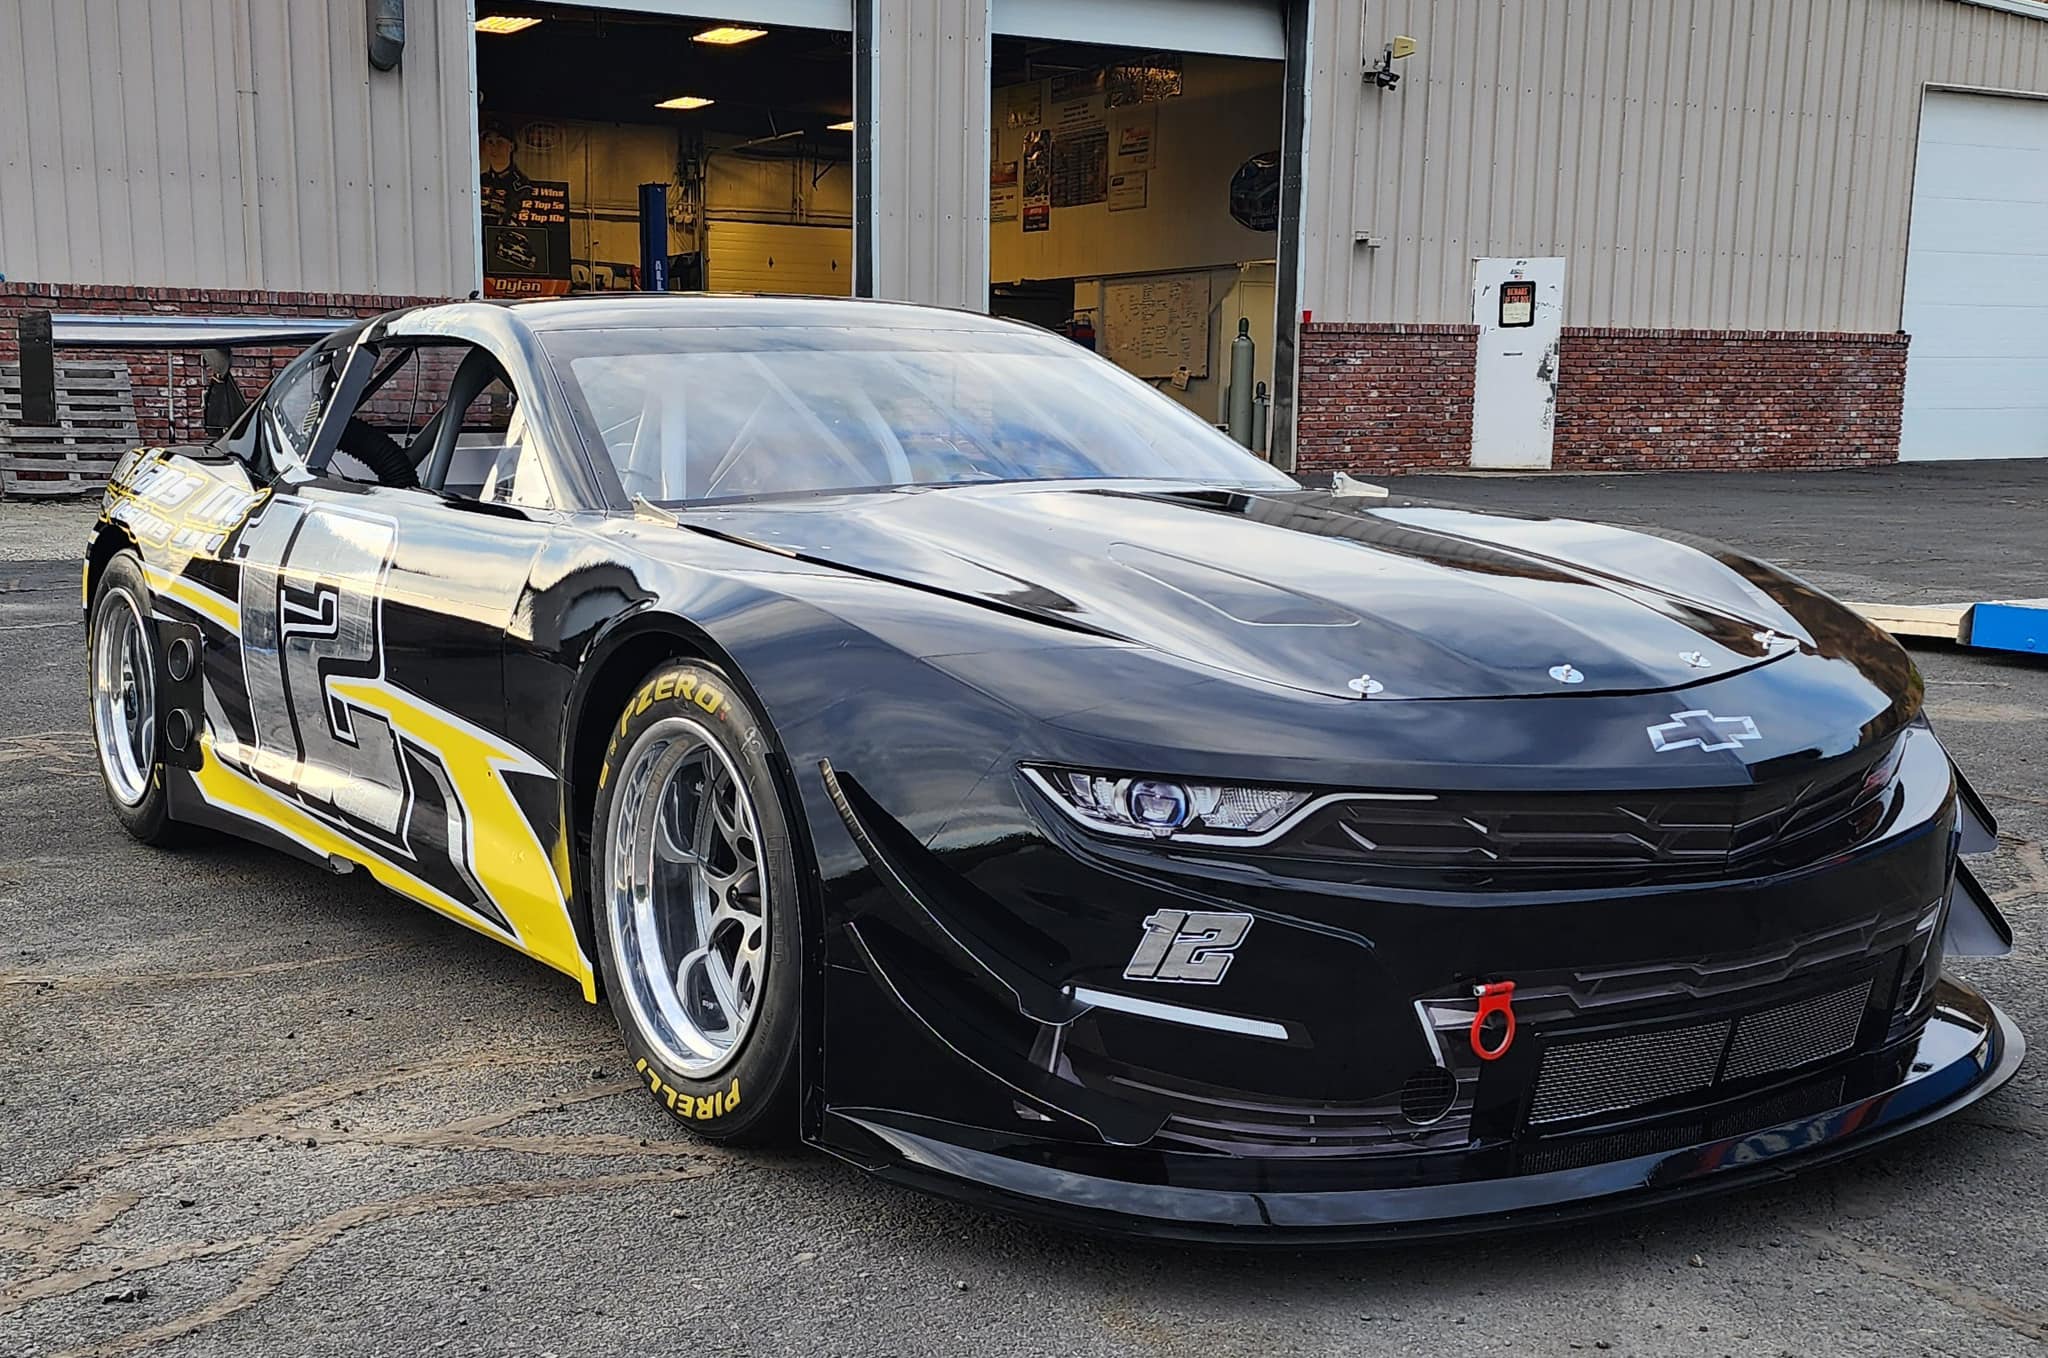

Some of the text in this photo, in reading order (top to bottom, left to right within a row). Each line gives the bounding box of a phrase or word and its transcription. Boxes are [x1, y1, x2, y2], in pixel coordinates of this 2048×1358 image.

[531, 187, 565, 197] 3 Wins
[521, 199, 565, 211] 12 Top 5s
[530, 212, 548, 223] Top
[548, 213, 565, 222] 10s
[495, 278, 542, 294] Dylan
[233, 495, 415, 855] 12
[1122, 908, 1255, 986] 12
